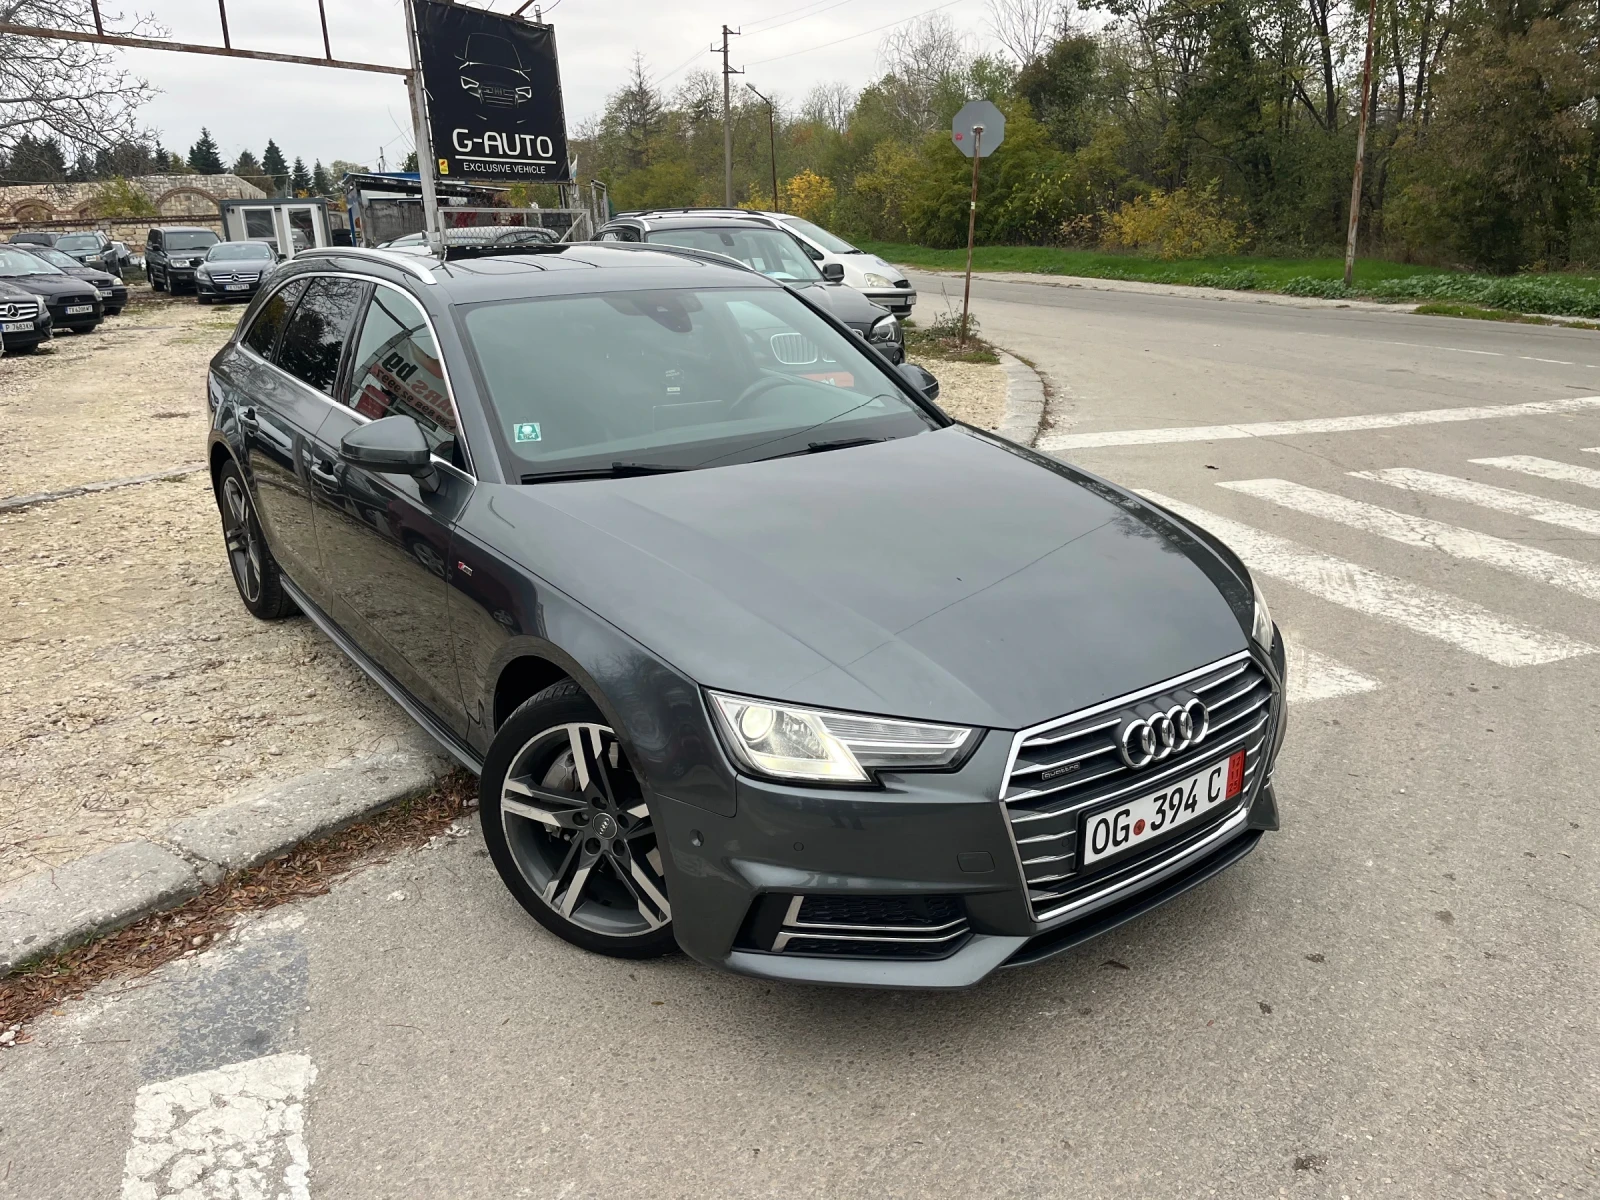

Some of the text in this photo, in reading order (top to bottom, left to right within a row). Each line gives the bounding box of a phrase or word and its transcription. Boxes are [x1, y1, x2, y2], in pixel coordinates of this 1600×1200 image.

[452, 128, 553, 158] G-AUTO
[463, 162, 546, 174] EXCLUSIVE VEHICLE
[1092, 766, 1222, 855] OG 394 C
